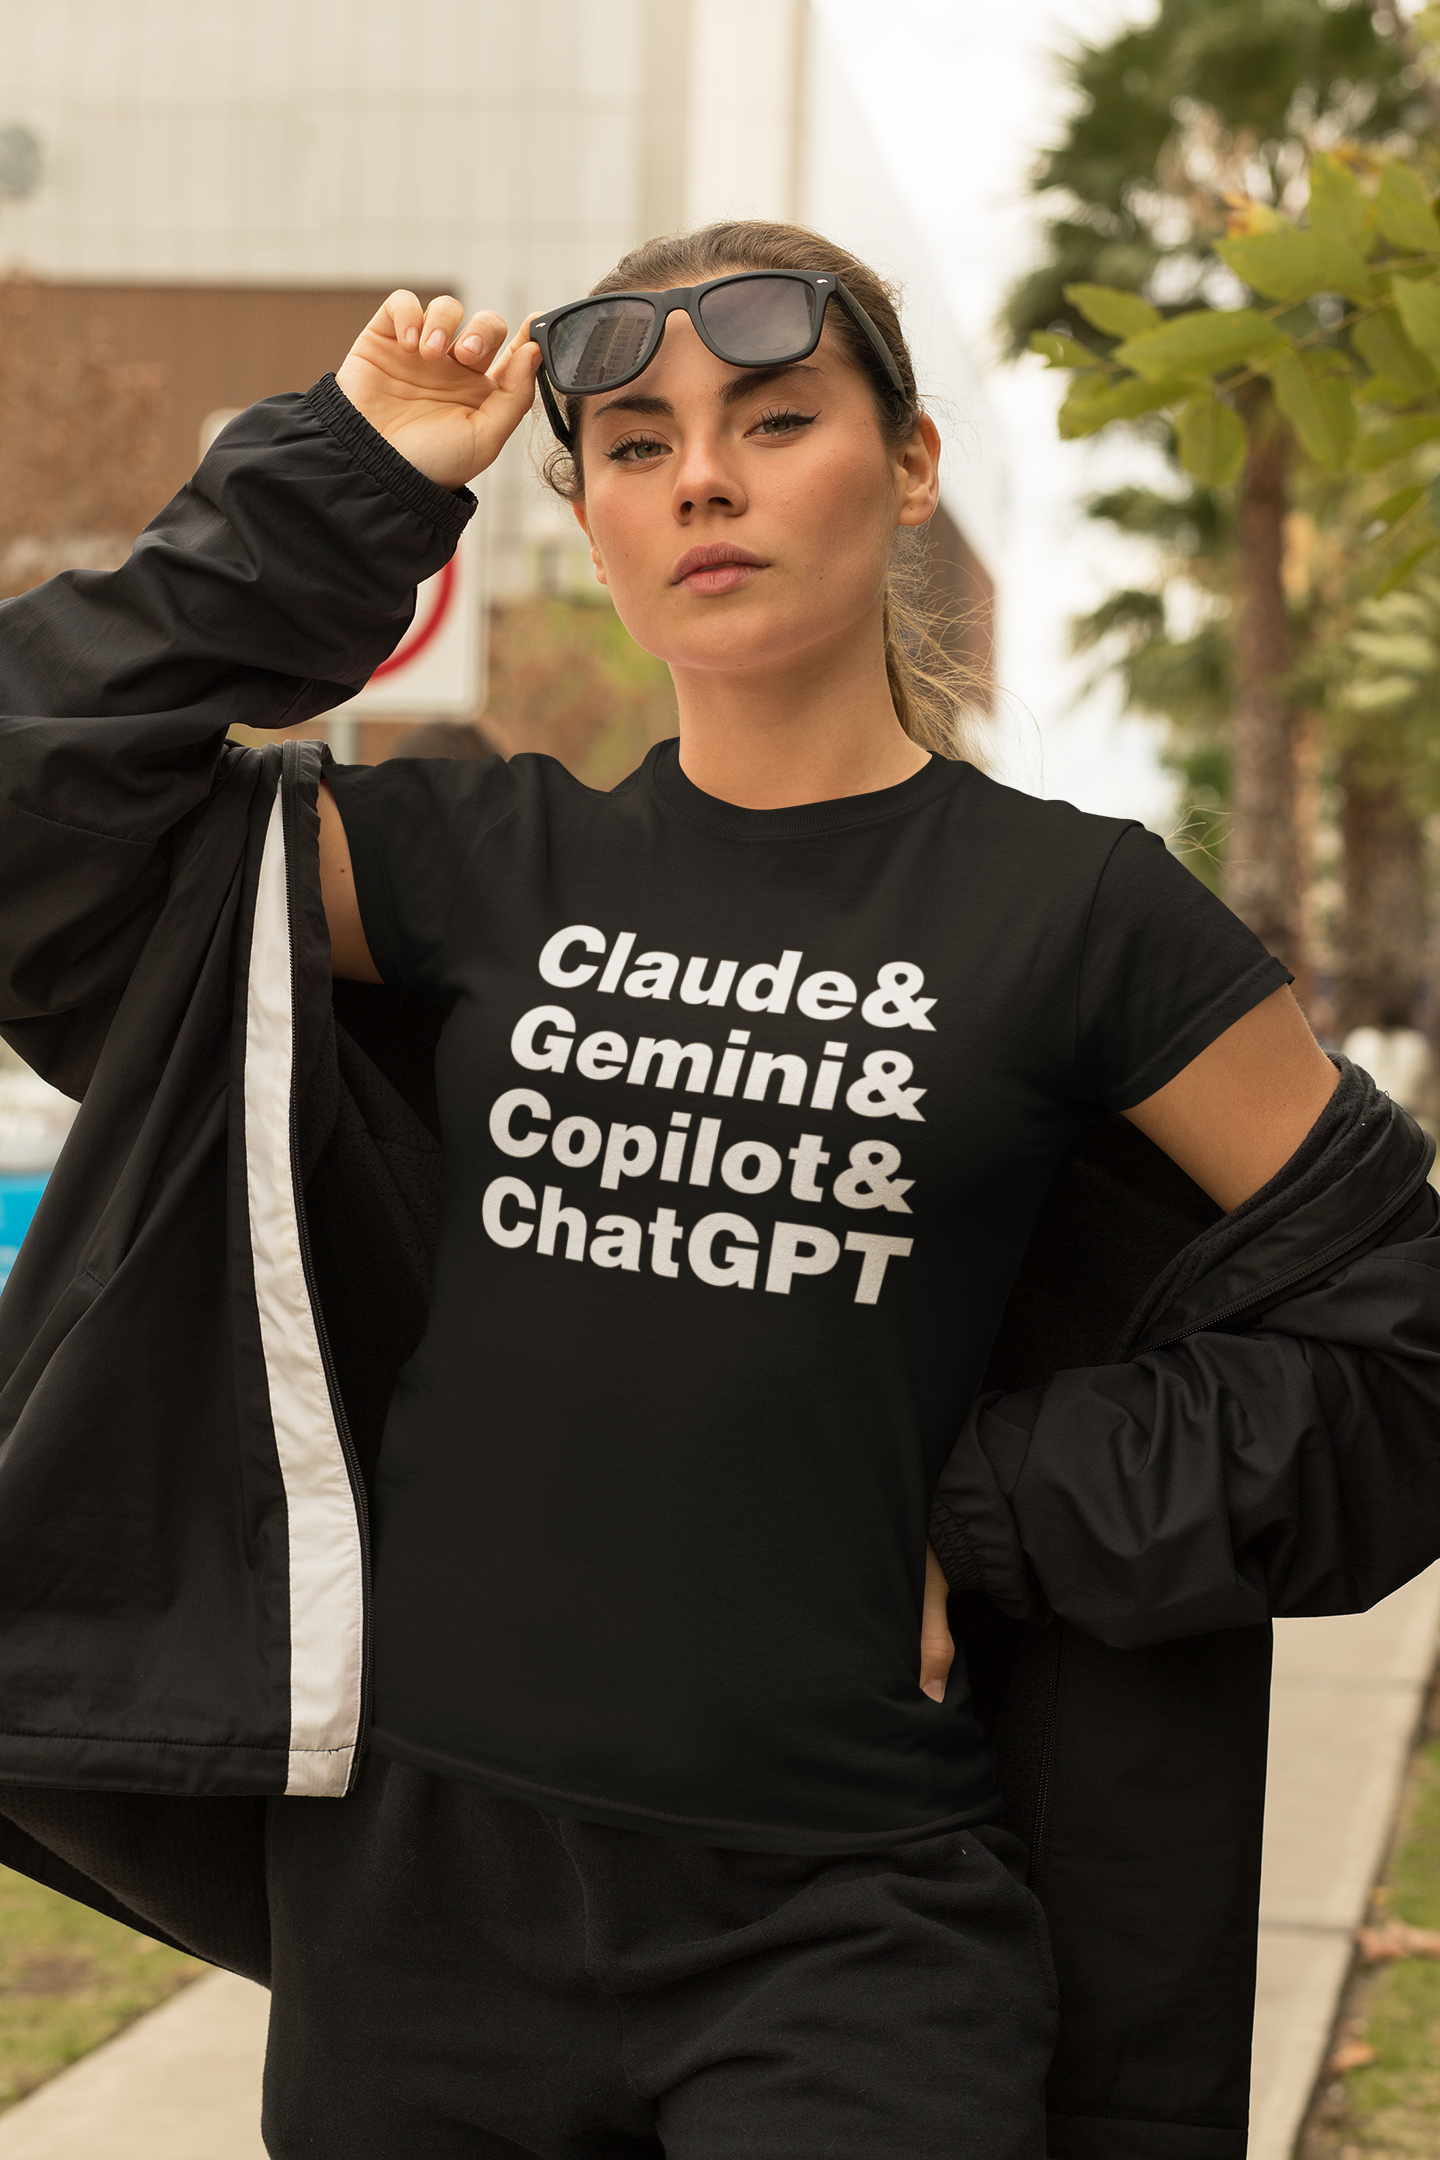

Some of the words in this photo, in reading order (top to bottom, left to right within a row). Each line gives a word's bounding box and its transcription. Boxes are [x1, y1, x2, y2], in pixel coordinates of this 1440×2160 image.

[538, 924, 938, 1032] Claude&
[510, 1004, 928, 1122] Gemini&
[488, 1088, 916, 1214] Copilot&
[481, 1175, 914, 1305] ChatGPT
